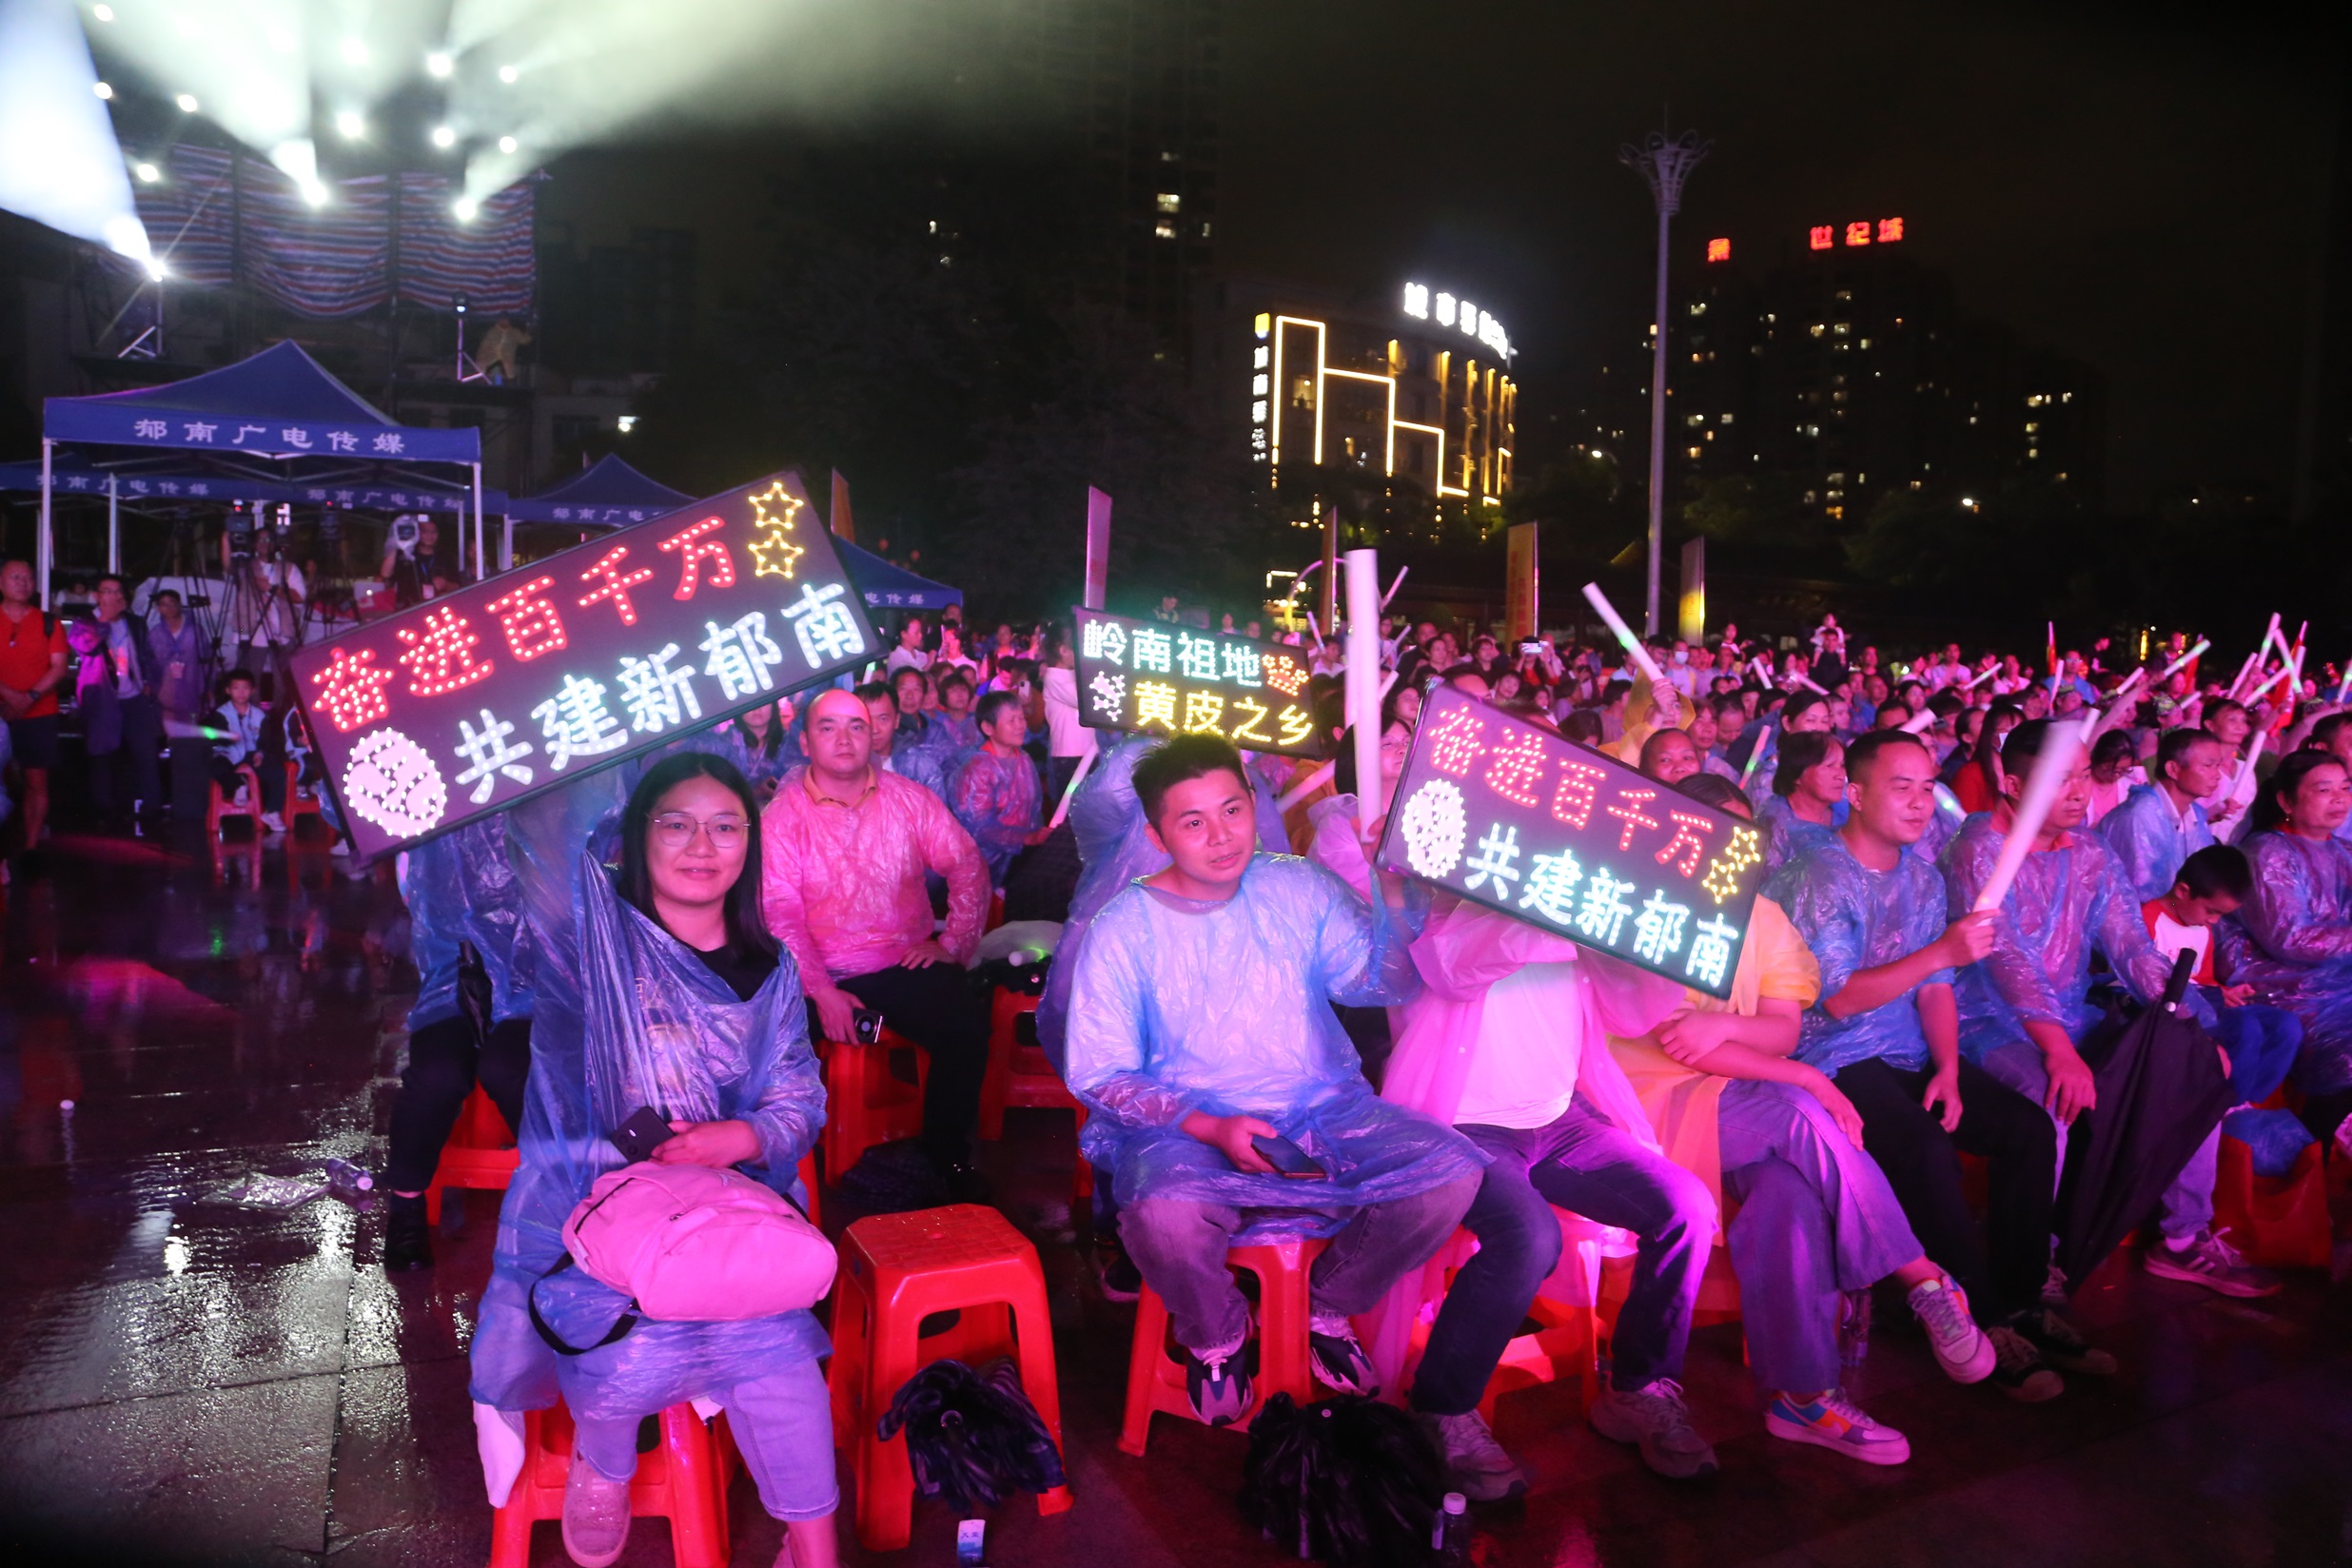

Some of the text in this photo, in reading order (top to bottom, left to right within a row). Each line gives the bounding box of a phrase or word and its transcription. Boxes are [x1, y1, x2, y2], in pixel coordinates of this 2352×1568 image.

[134, 419, 404, 454] 郁南广电传媒
[553, 507, 659, 521] 郁南广电
[312, 515, 736, 731] 奋进百千万
[1083, 618, 1263, 687] 岭南祖地
[454, 582, 867, 804] 共建新郁南
[1133, 680, 1314, 746] 黄皮之乡
[1427, 701, 1715, 878] 奋进百千万
[1463, 822, 1740, 990] 共建新郁南
